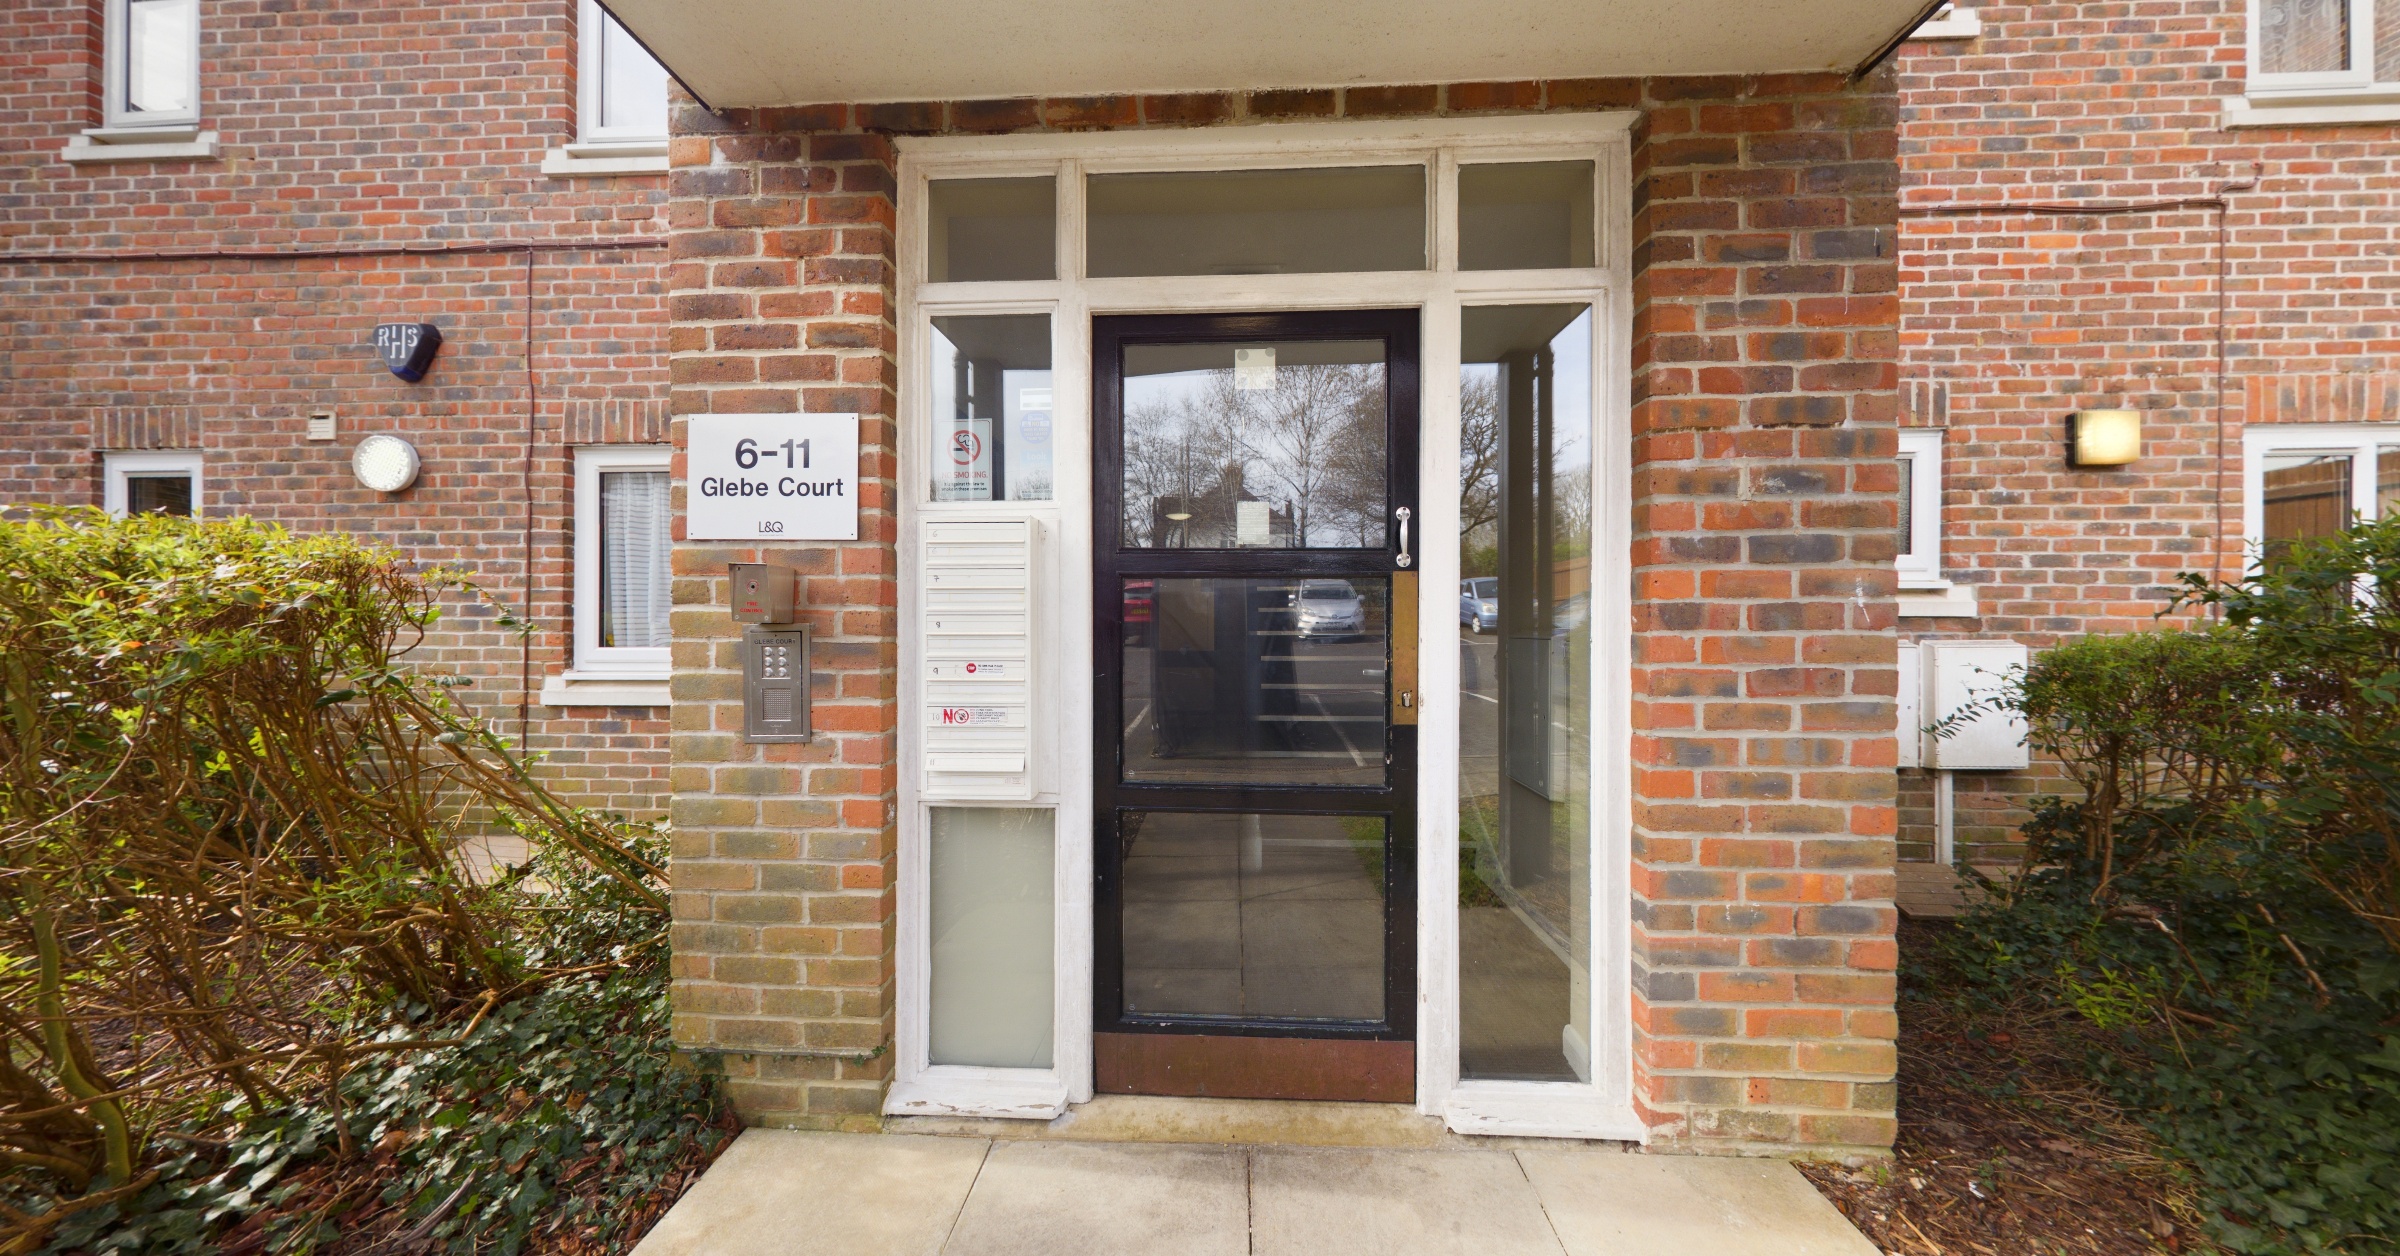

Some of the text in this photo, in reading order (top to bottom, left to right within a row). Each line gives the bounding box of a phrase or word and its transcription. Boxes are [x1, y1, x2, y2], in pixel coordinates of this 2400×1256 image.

[377, 325, 419, 359] RHS
[735, 438, 810, 469] 6-11
[700, 476, 844, 497] Glebe Court
[758, 520, 784, 533] L&Q
